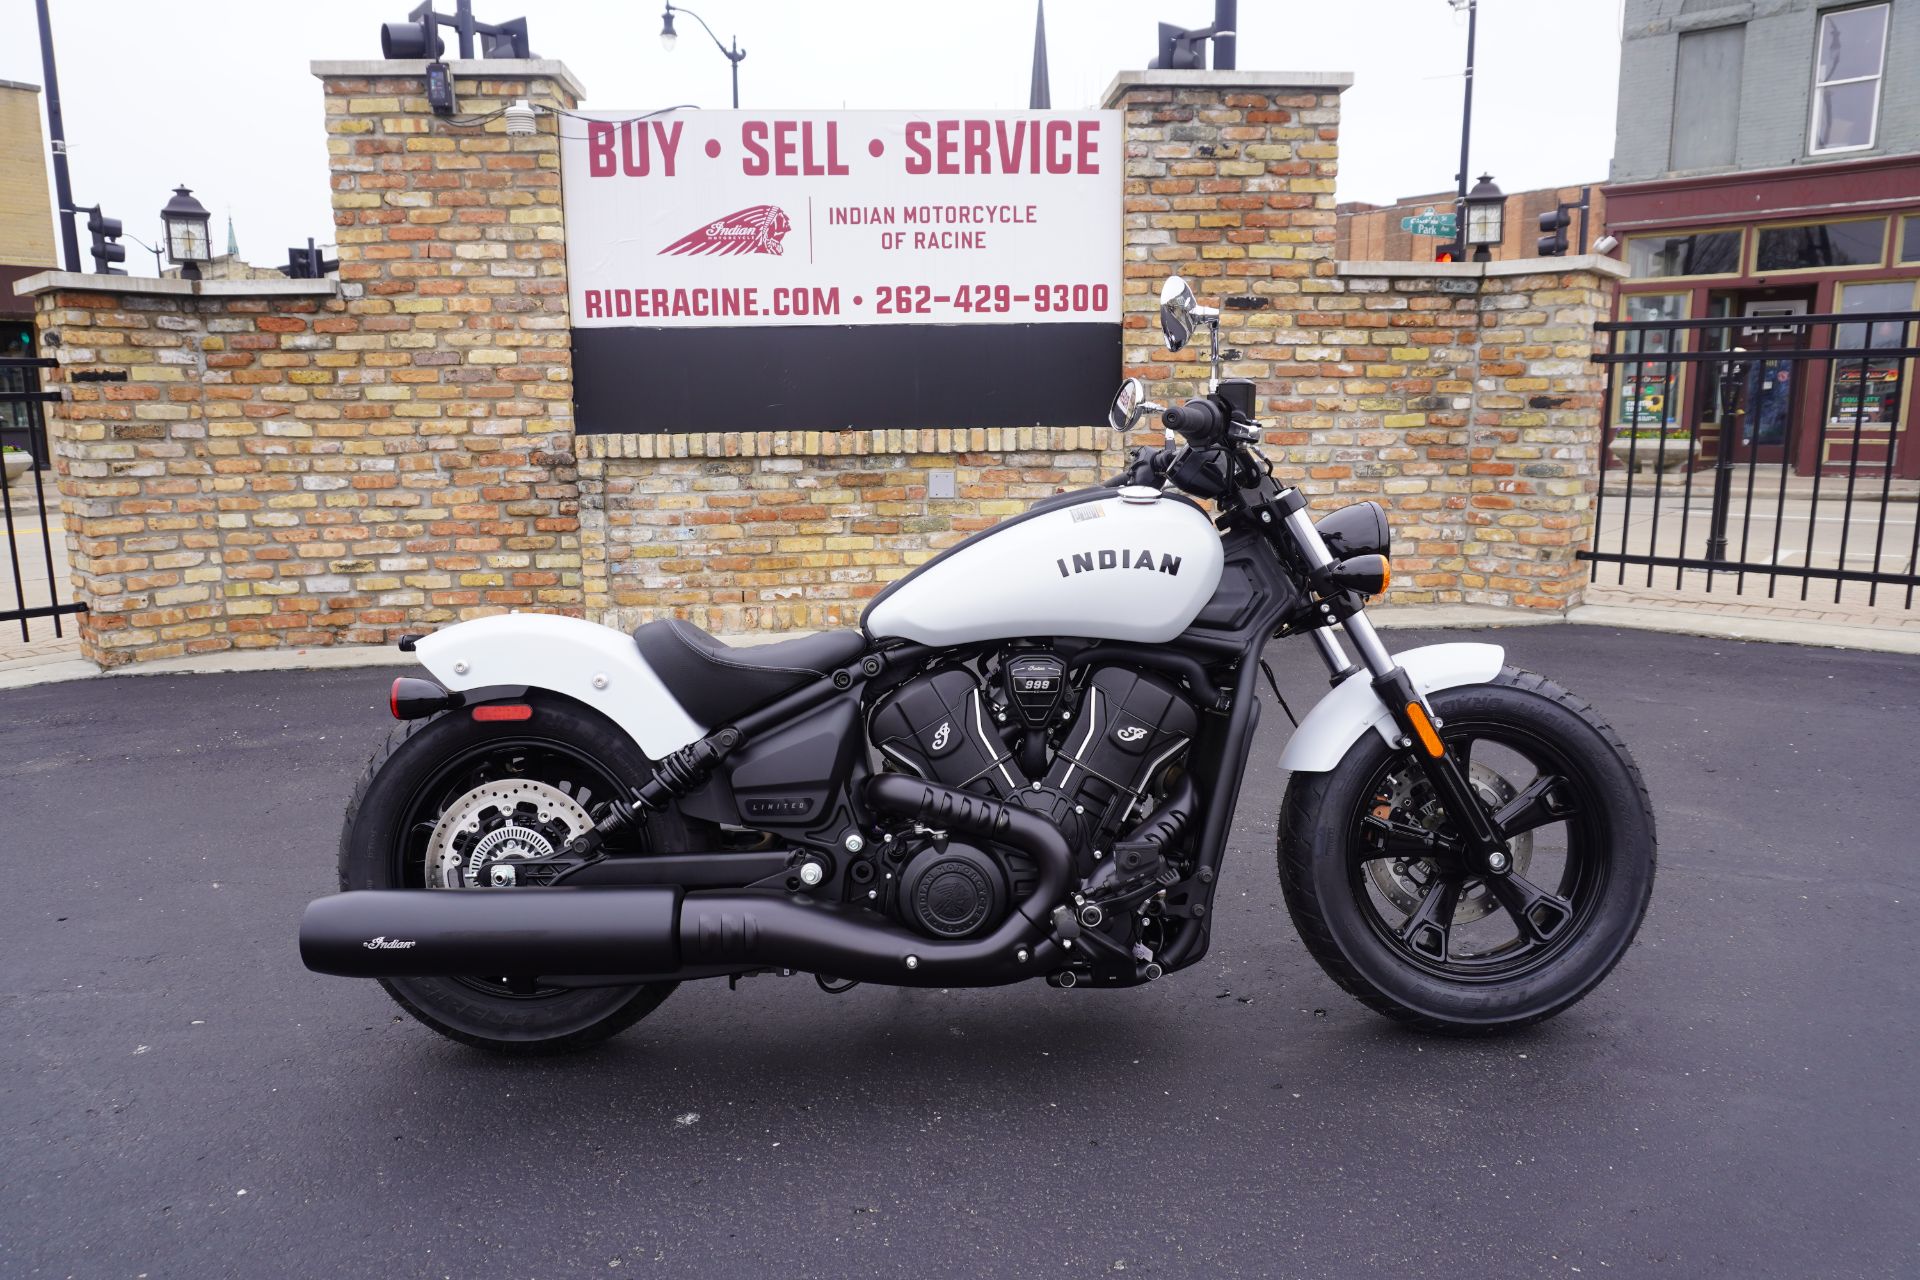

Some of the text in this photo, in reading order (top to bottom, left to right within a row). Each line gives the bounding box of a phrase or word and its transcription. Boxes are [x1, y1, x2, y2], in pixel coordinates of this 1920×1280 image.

[588, 119, 1100, 178] BUY SELL SERVICE
[828, 205, 1038, 225] INDIAN MOTORCYCLE
[707, 222, 756, 236] Indian
[1418, 224, 1437, 235] Park
[881, 231, 987, 249] OF RACINE
[584, 286, 841, 319] RIDERACINE.COM
[876, 283, 1110, 315] 262-429-9300
[1057, 549, 1182, 578] INDIAN
[1025, 680, 1050, 690] 999
[752, 801, 805, 811] LIMITED
[919, 863, 988, 920] INDIAN MOTORCYCLE
[367, 936, 412, 950] Indian
